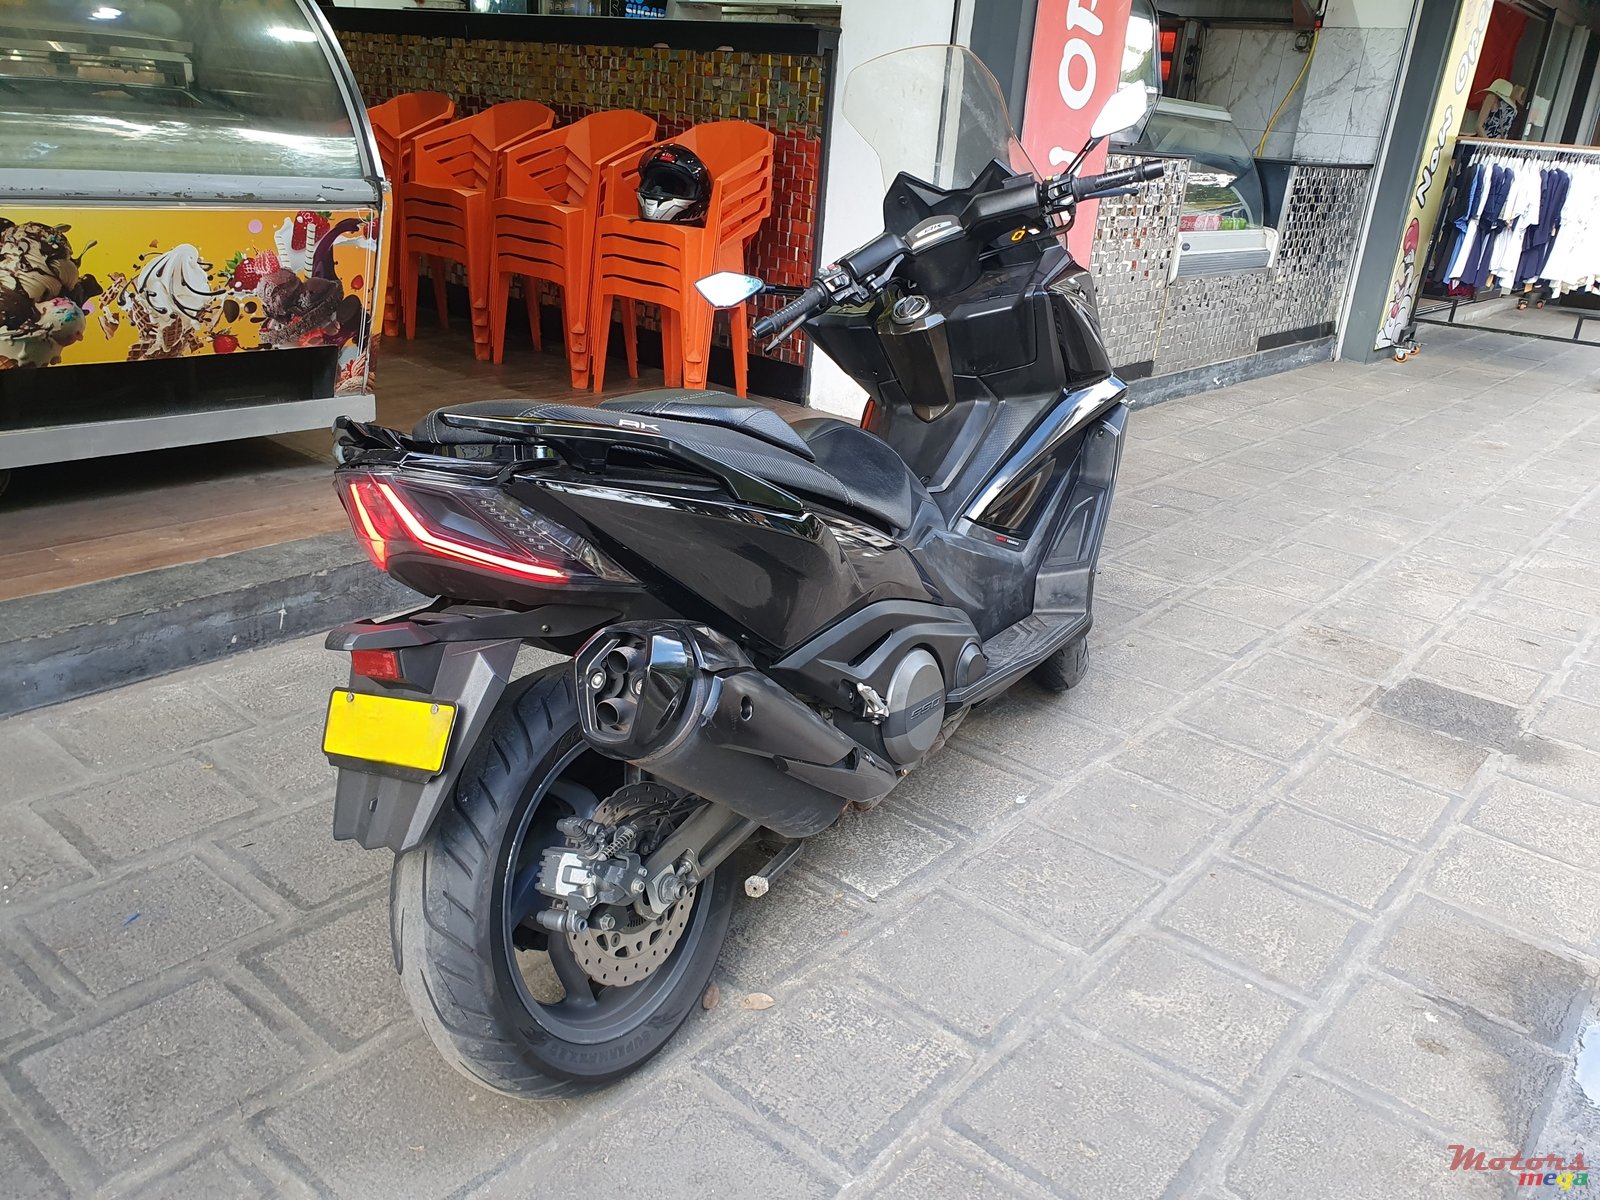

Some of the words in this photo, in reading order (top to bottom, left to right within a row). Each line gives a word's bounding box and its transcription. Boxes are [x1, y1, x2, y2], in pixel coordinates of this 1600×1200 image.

[1416, 104, 1453, 209] Now
[618, 418, 661, 432] AK
[910, 695, 942, 720] 550
